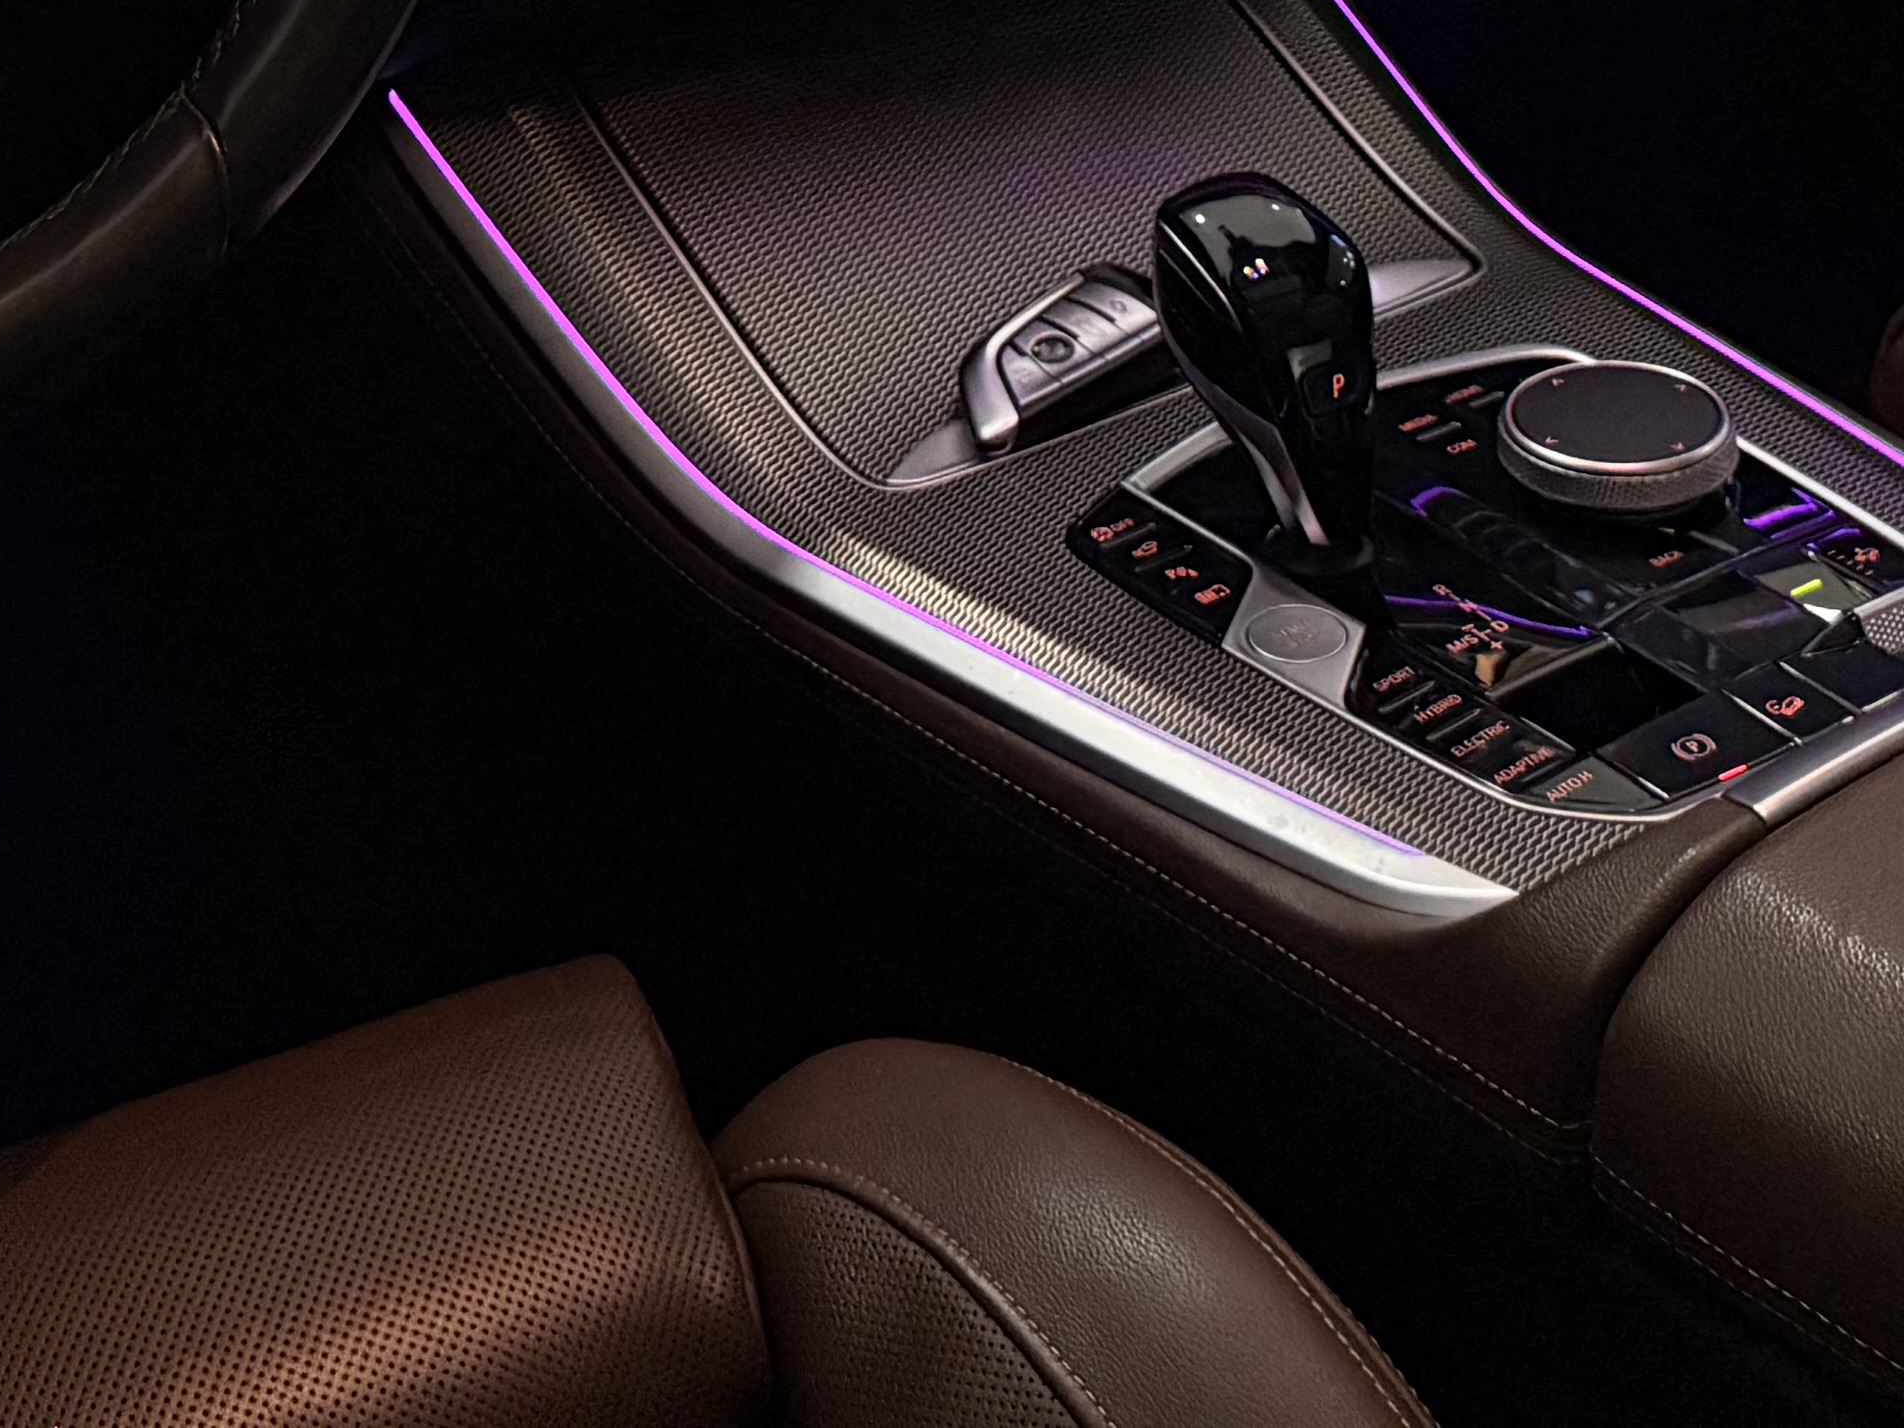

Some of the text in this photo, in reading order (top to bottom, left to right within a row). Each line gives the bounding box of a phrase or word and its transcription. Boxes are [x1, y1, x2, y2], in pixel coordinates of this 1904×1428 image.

[1333, 373, 1345, 399] P
[1372, 665, 1416, 693] SPORT
[1413, 694, 1464, 725] HYBRID
[1450, 719, 1512, 759] ELECTRIC
[1493, 746, 1556, 785] ADAPTIVE
[1546, 769, 1594, 803] AUTO H
